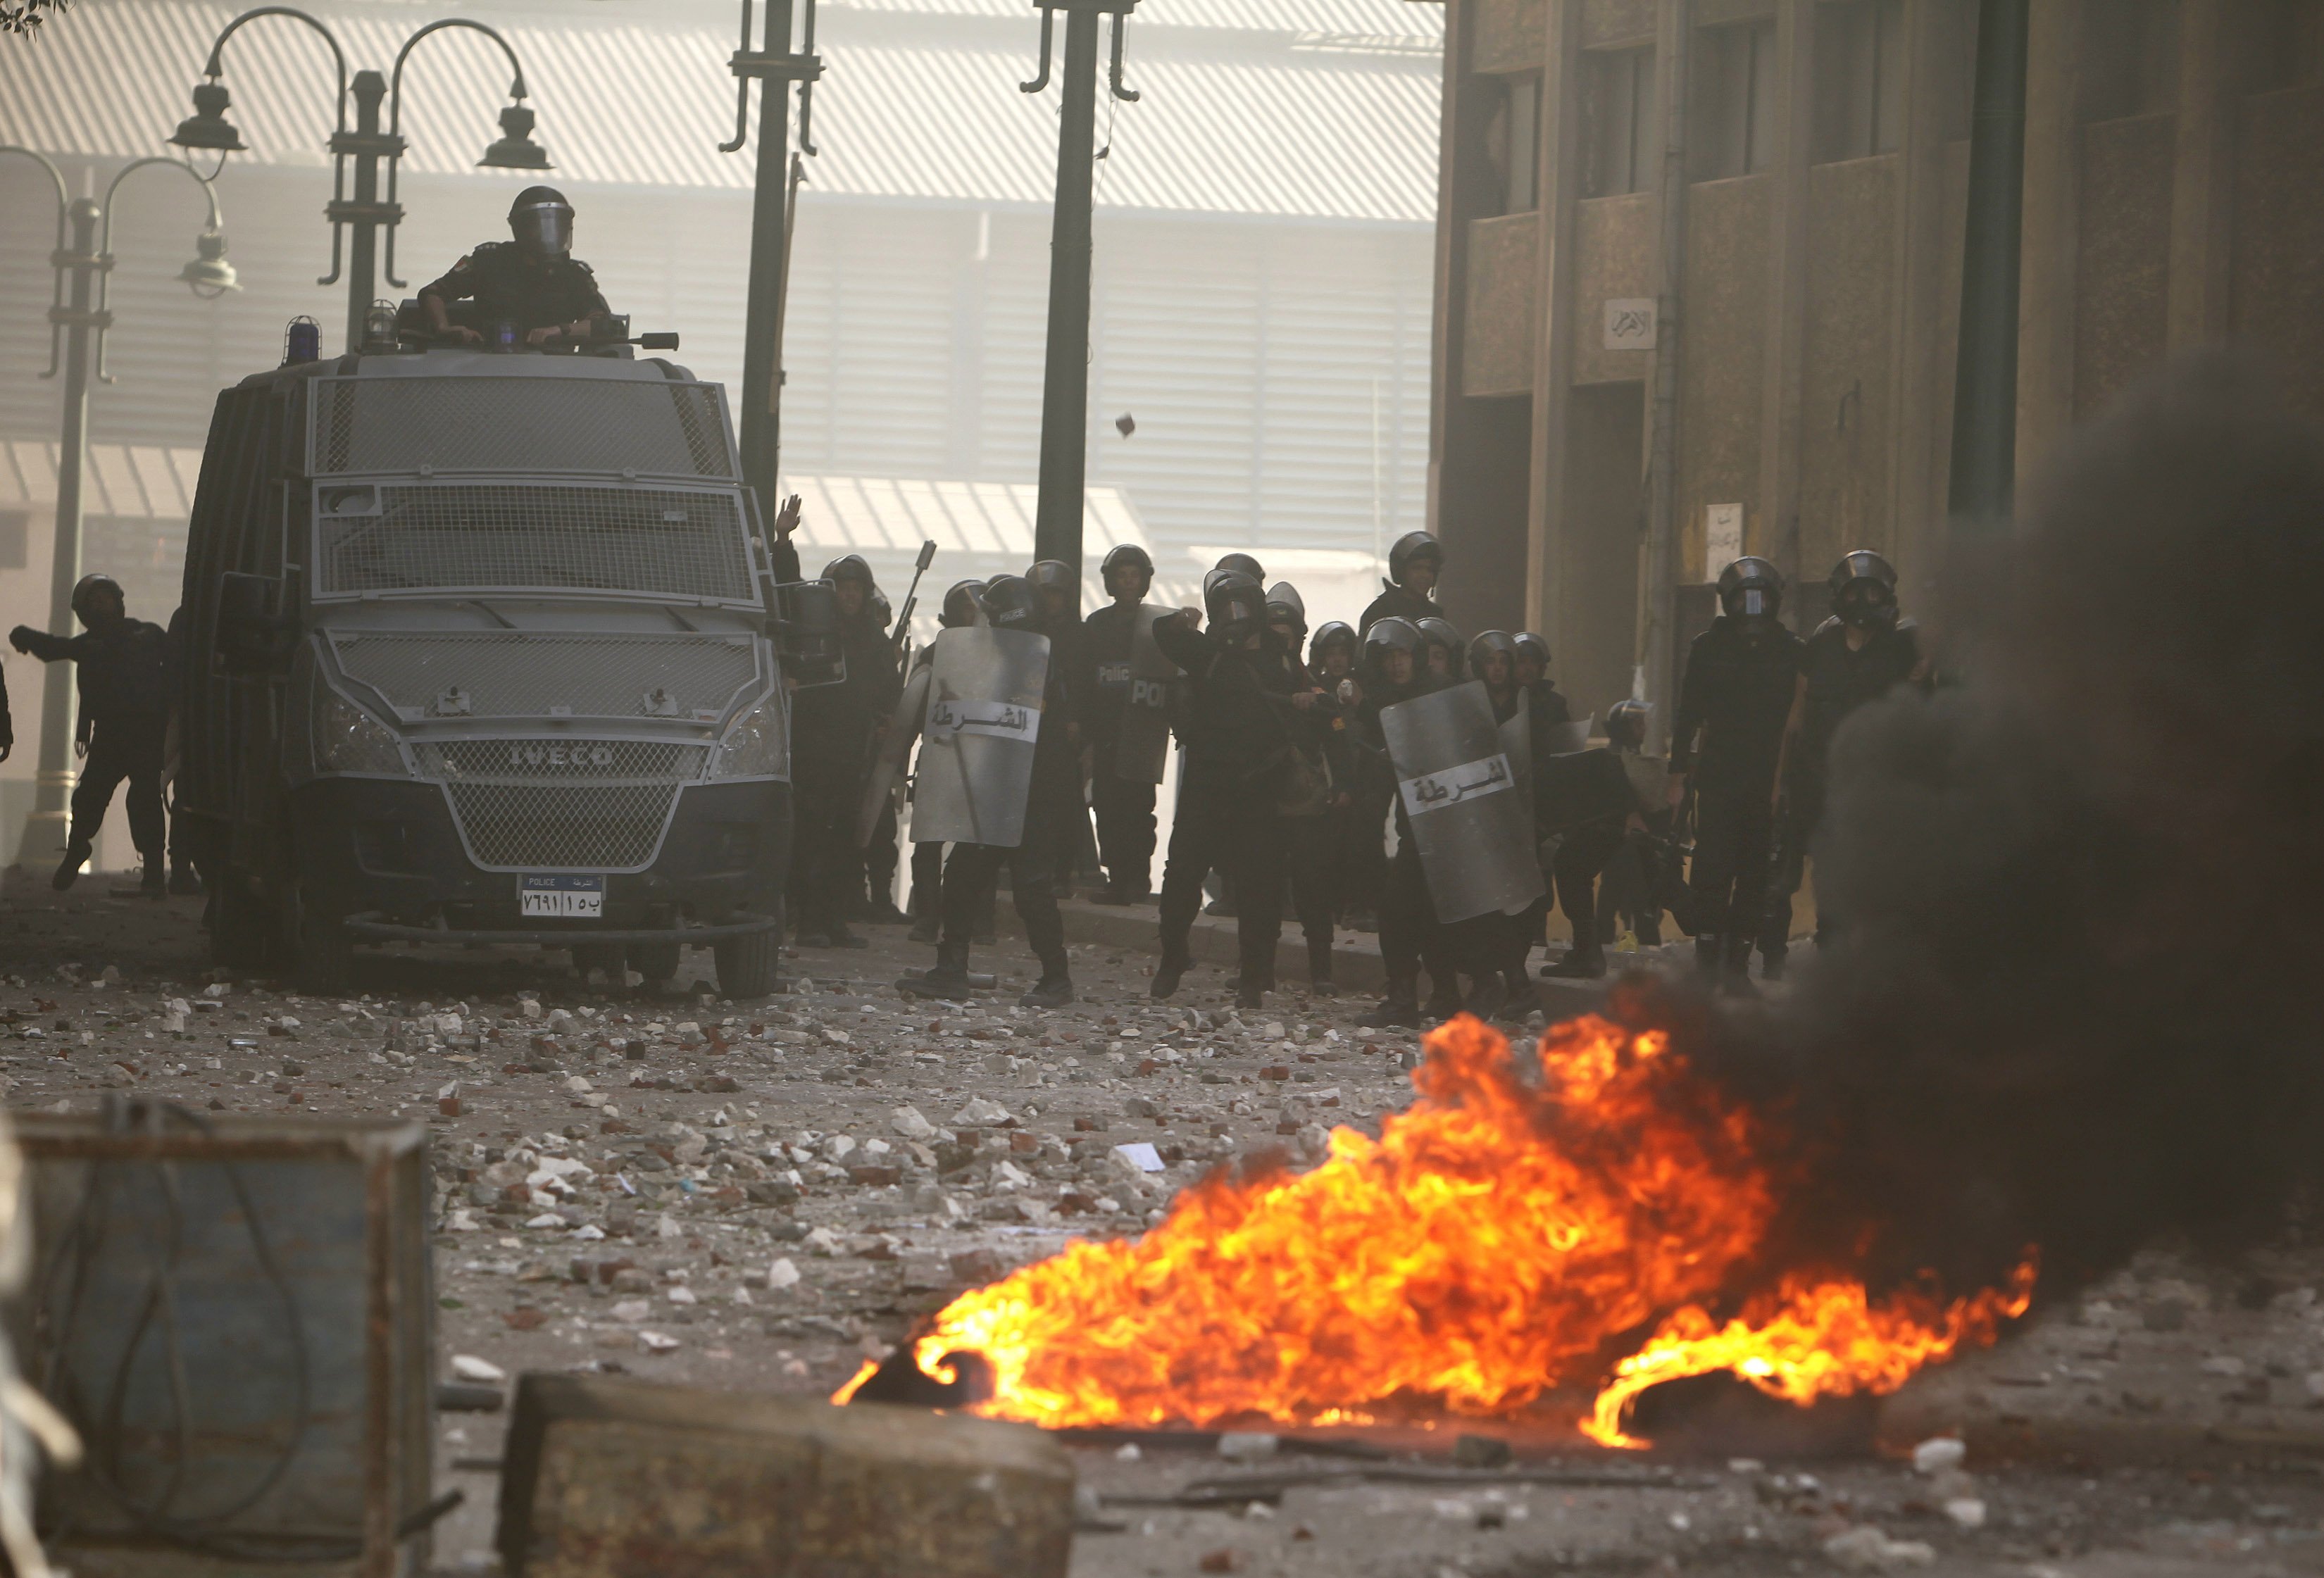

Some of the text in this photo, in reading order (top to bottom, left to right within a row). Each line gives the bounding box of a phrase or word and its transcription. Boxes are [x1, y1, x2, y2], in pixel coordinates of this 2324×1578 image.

[931, 703, 1027, 733] الشرطة
[512, 746, 611, 765] IVECO
[529, 877, 556, 887] POLICE
[523, 894, 557, 910] ٧٦٩١
